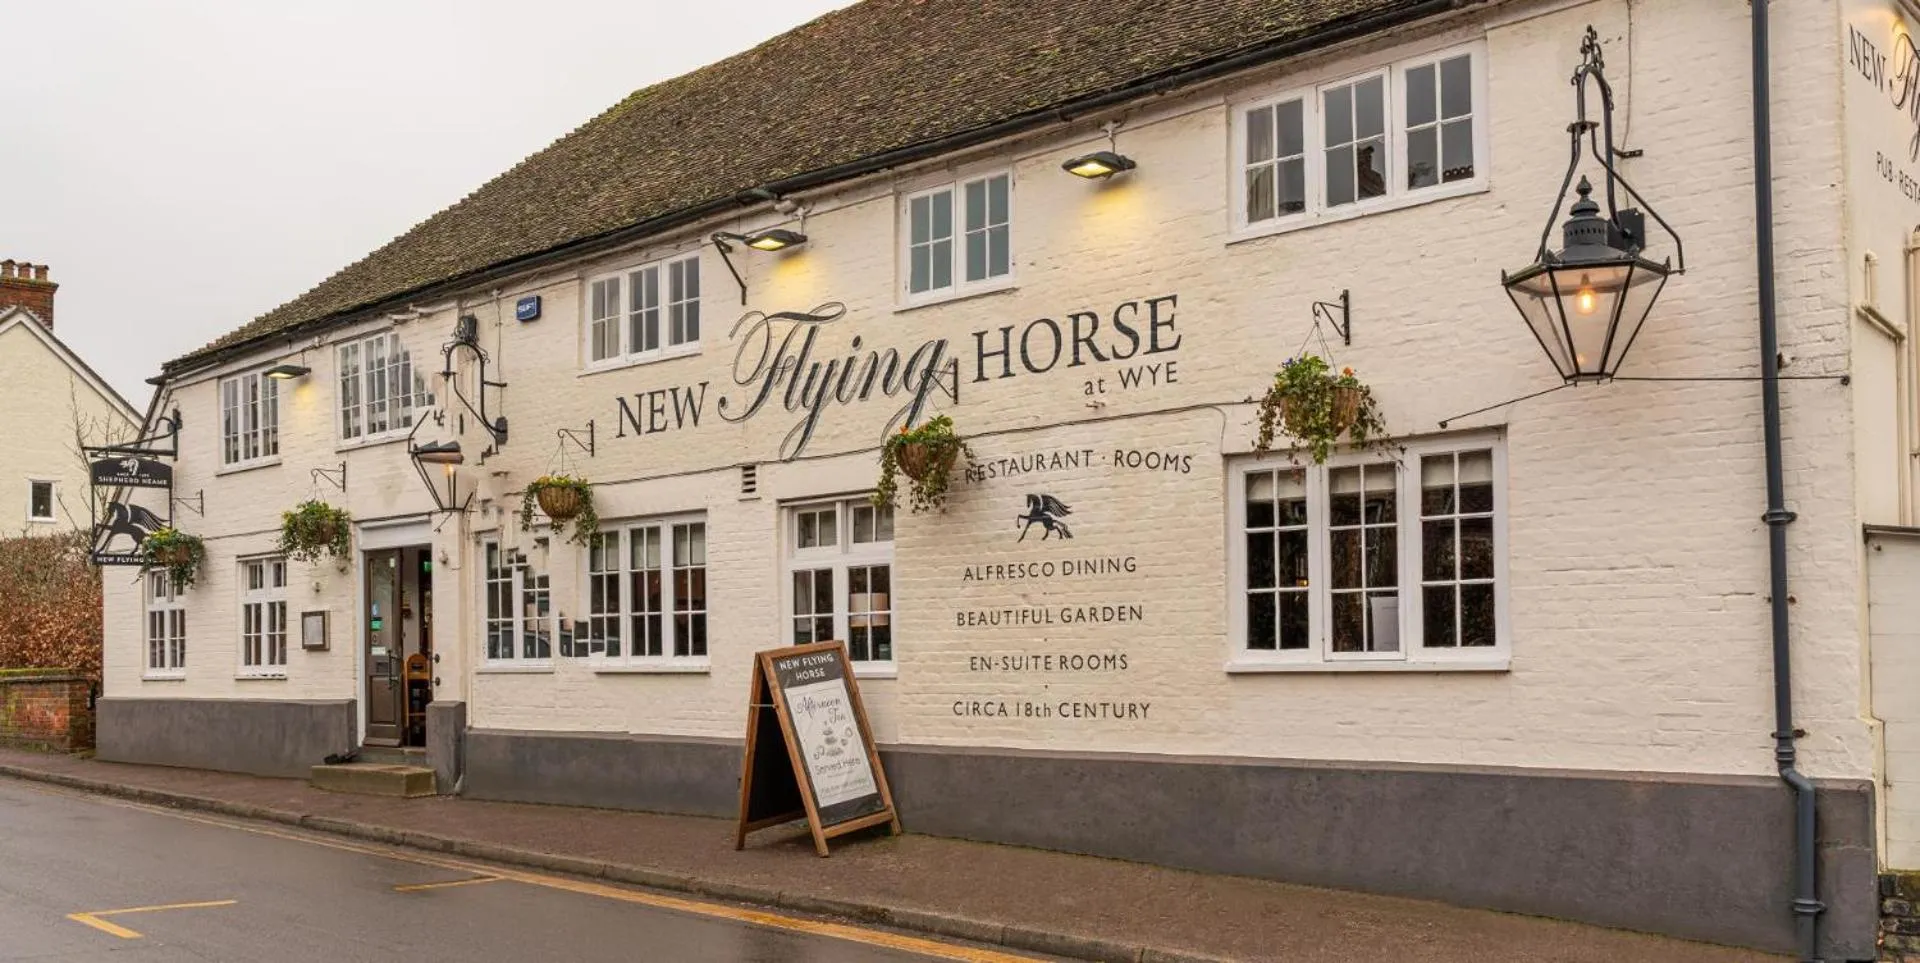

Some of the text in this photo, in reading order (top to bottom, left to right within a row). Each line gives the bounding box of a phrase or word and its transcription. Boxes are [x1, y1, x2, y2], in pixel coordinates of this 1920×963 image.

[1850, 23, 1886, 93] NEW
[1877, 151, 1893, 183] PUB
[616, 294, 1182, 461] NEW Flying HORSE
[1084, 361, 1178, 396] at WYE
[965, 450, 1194, 484] RESTAURANT ROOMS
[98, 476, 139, 484] SHEPHERD
[963, 557, 1137, 582] ALFRESCO DINING
[957, 605, 1144, 627] BEAUTIFUL GARDEN
[780, 653, 835, 671] NEW FLYING
[970, 654, 1129, 671] EN-SUITE ROOMS
[796, 667, 826, 681] HORSE
[953, 701, 1152, 719] CIRCA 18th CENTURY
